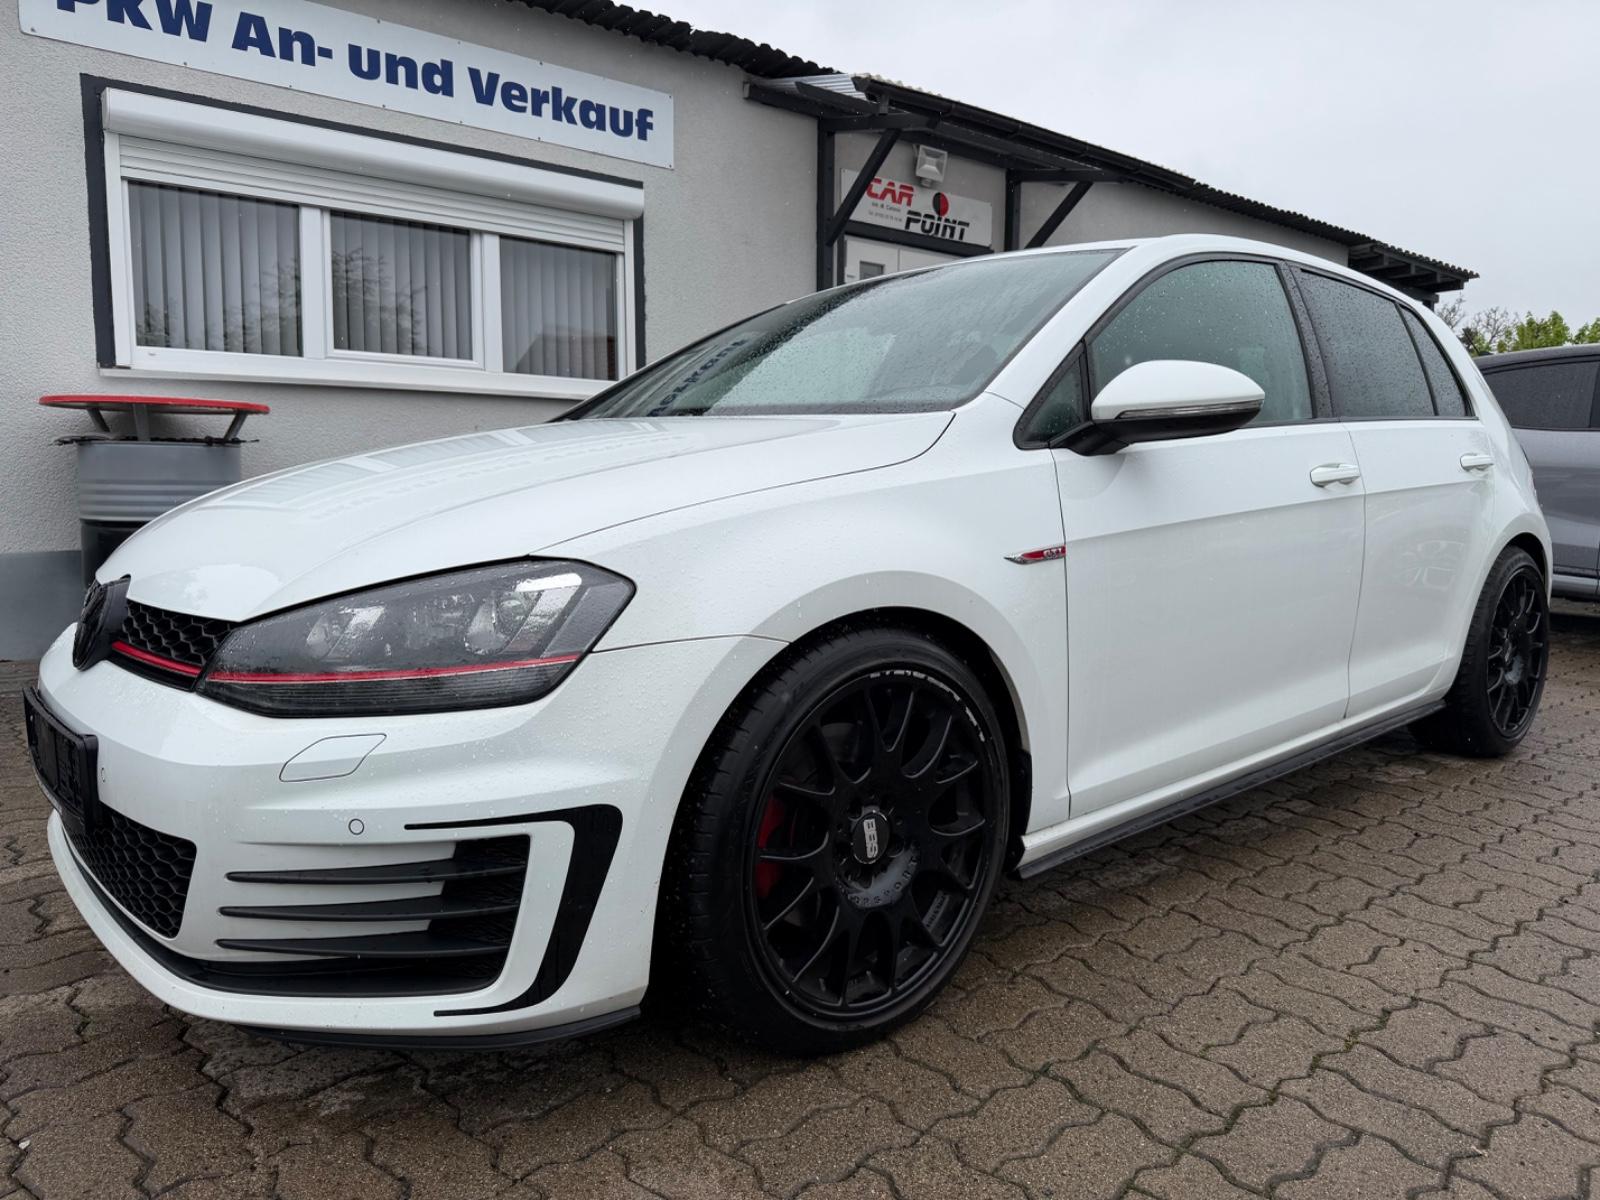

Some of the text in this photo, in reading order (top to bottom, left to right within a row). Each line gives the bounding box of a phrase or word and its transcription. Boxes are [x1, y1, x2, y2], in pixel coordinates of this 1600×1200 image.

[57, 0, 654, 141] KW An- und Verkauf
[867, 178, 914, 207] CAR
[905, 211, 970, 241] POINT
